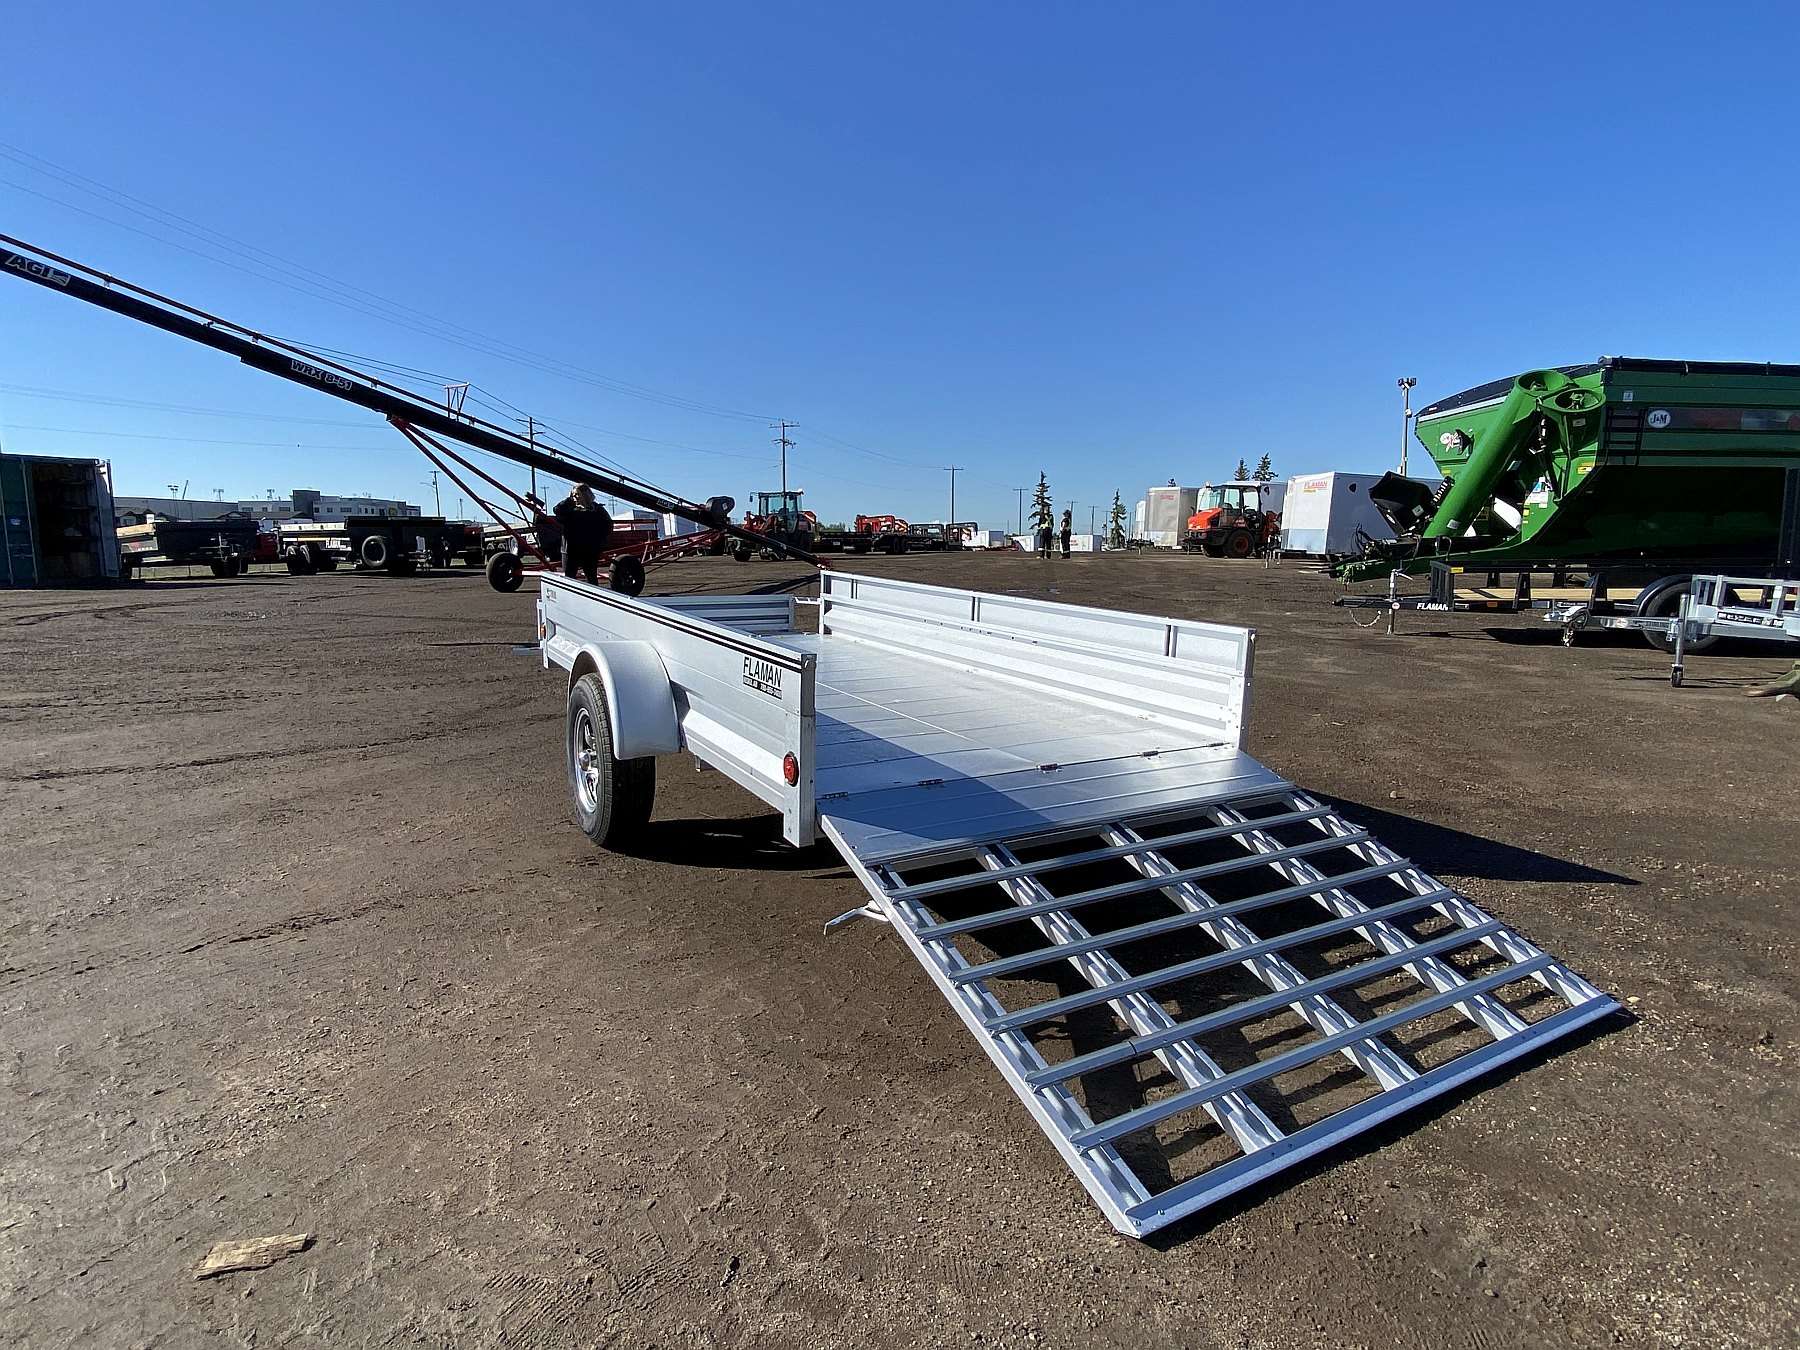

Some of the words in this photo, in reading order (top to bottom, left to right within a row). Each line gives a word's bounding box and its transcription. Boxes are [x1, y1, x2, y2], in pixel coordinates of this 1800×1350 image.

[5, 254, 54, 280] AGI
[1650, 413, 1668, 424] J&M
[1416, 602, 1449, 611] FLAMAN
[743, 656, 782, 688] FLAMAN
